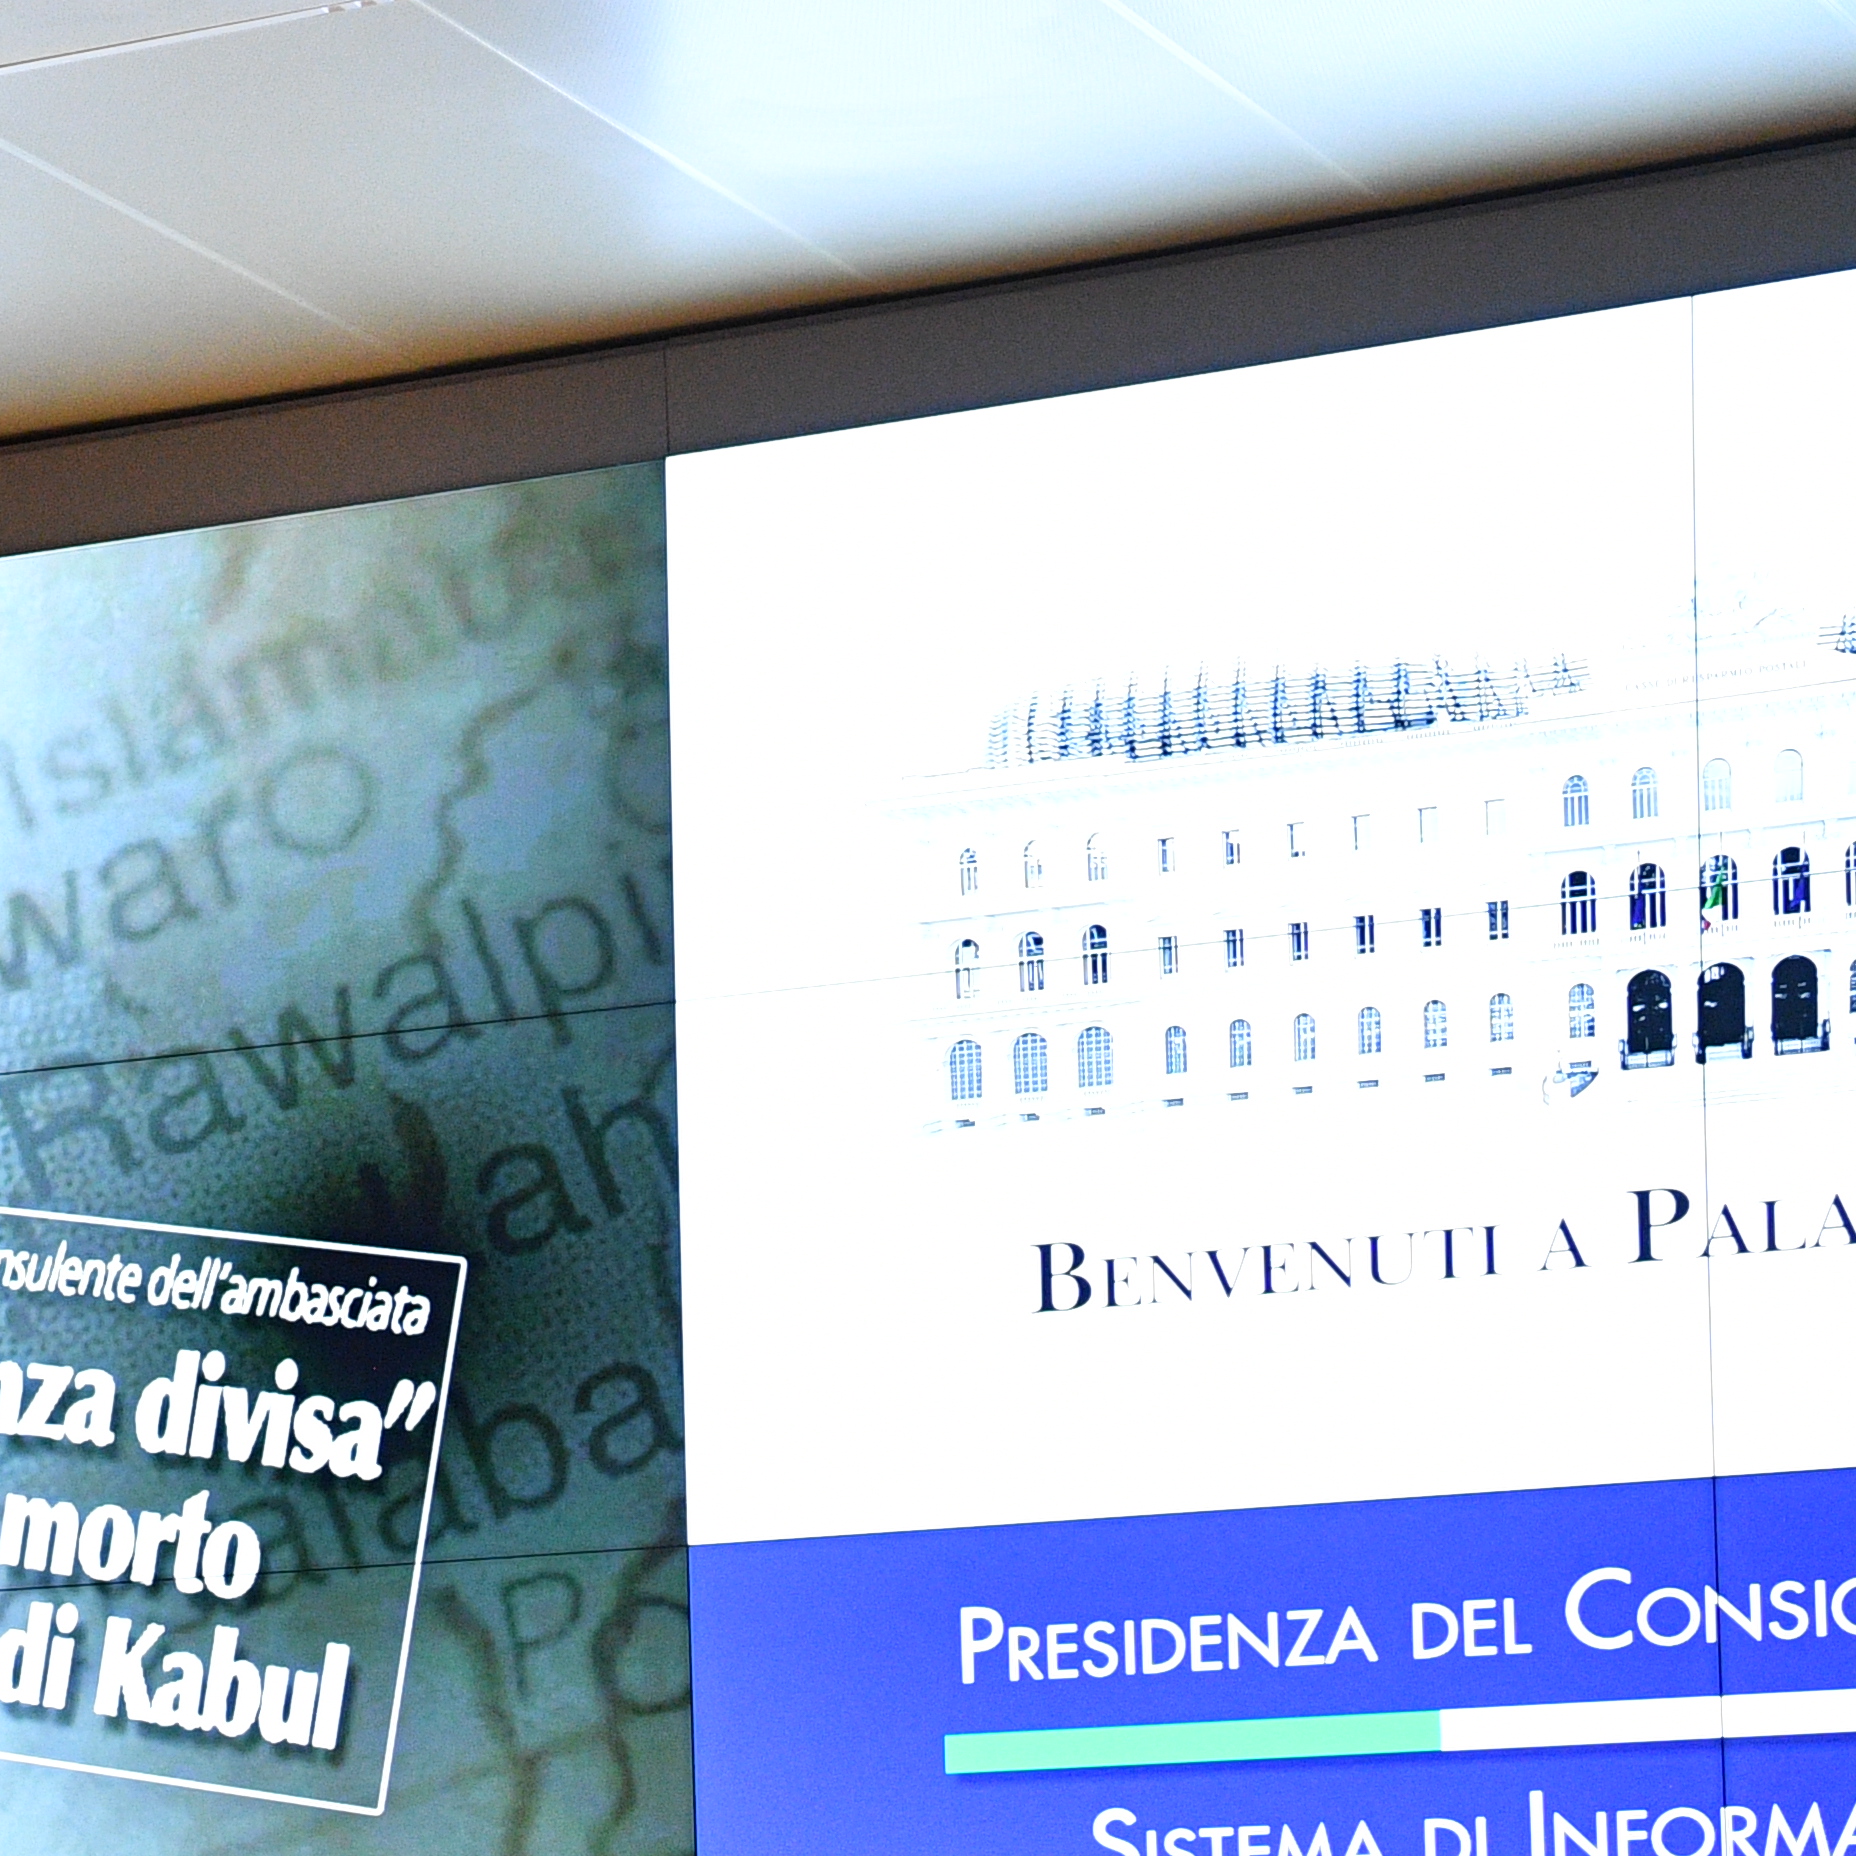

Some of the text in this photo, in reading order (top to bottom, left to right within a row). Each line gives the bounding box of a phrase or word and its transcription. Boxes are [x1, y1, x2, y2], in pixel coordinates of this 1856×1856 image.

[1029, 1225, 1500, 1314] BENVENUTI
[1539, 1217, 1592, 1272] A
[92, 1612, 351, 1751] Kabul
[958, 1603, 1379, 1685] PRESIDENZA
[1411, 1597, 1533, 1661] DEL
